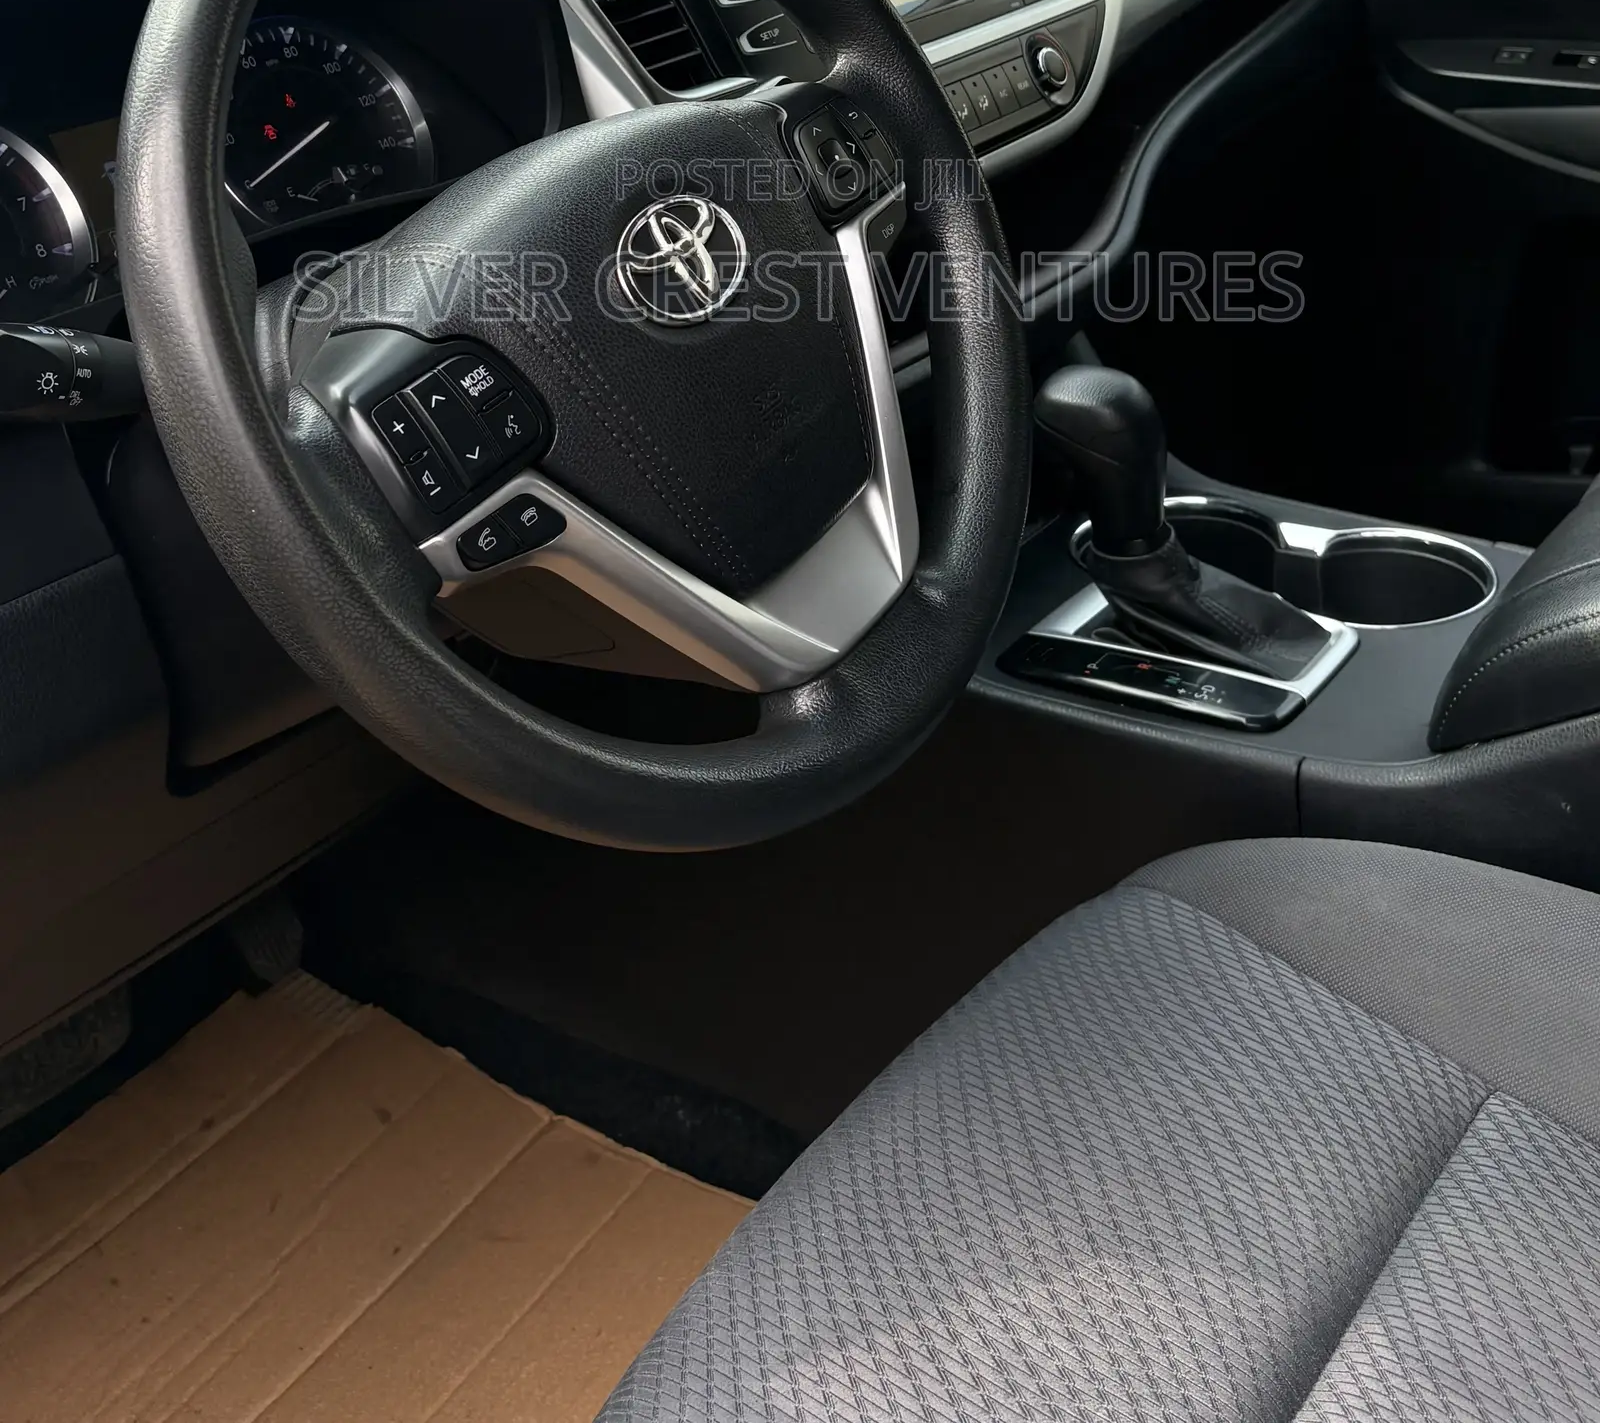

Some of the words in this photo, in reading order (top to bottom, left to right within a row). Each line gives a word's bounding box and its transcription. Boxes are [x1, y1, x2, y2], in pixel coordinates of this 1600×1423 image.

[760, 28, 780, 42] SETUP
[283, 46, 299, 59] 80
[242, 56, 257, 69] 60
[323, 62, 342, 74] 100
[358, 94, 376, 108] 120
[378, 136, 397, 150] 140
[286, 186, 296, 198] E
[17, 196, 27, 212] 7
[881, 223, 895, 239] DISP
[35, 243, 47, 258] 8
[5, 275, 17, 289] H
[76, 367, 92, 379] AUTO
[459, 364, 490, 390] MODE
[475, 375, 495, 394] HOLD
[1087, 662, 1099, 670] P
[1201, 685, 1215, 693] D
